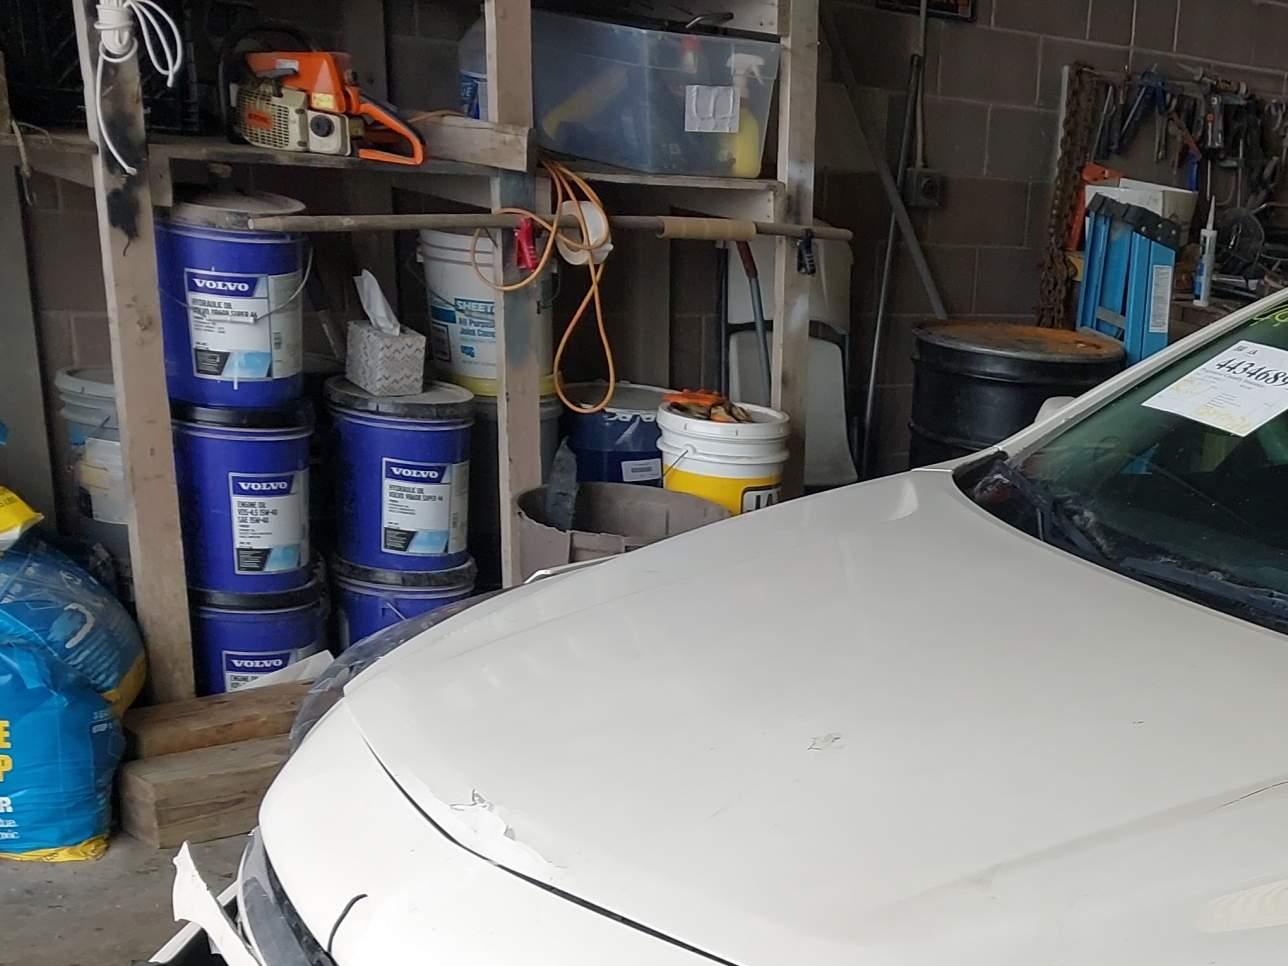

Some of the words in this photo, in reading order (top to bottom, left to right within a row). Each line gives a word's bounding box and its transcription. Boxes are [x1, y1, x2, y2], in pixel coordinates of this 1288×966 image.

[193, 278, 249, 291] VOLVO
[390, 466, 438, 478] VOLVO
[238, 481, 288, 491] VOLVO
[231, 659, 283, 668] VOLVO
